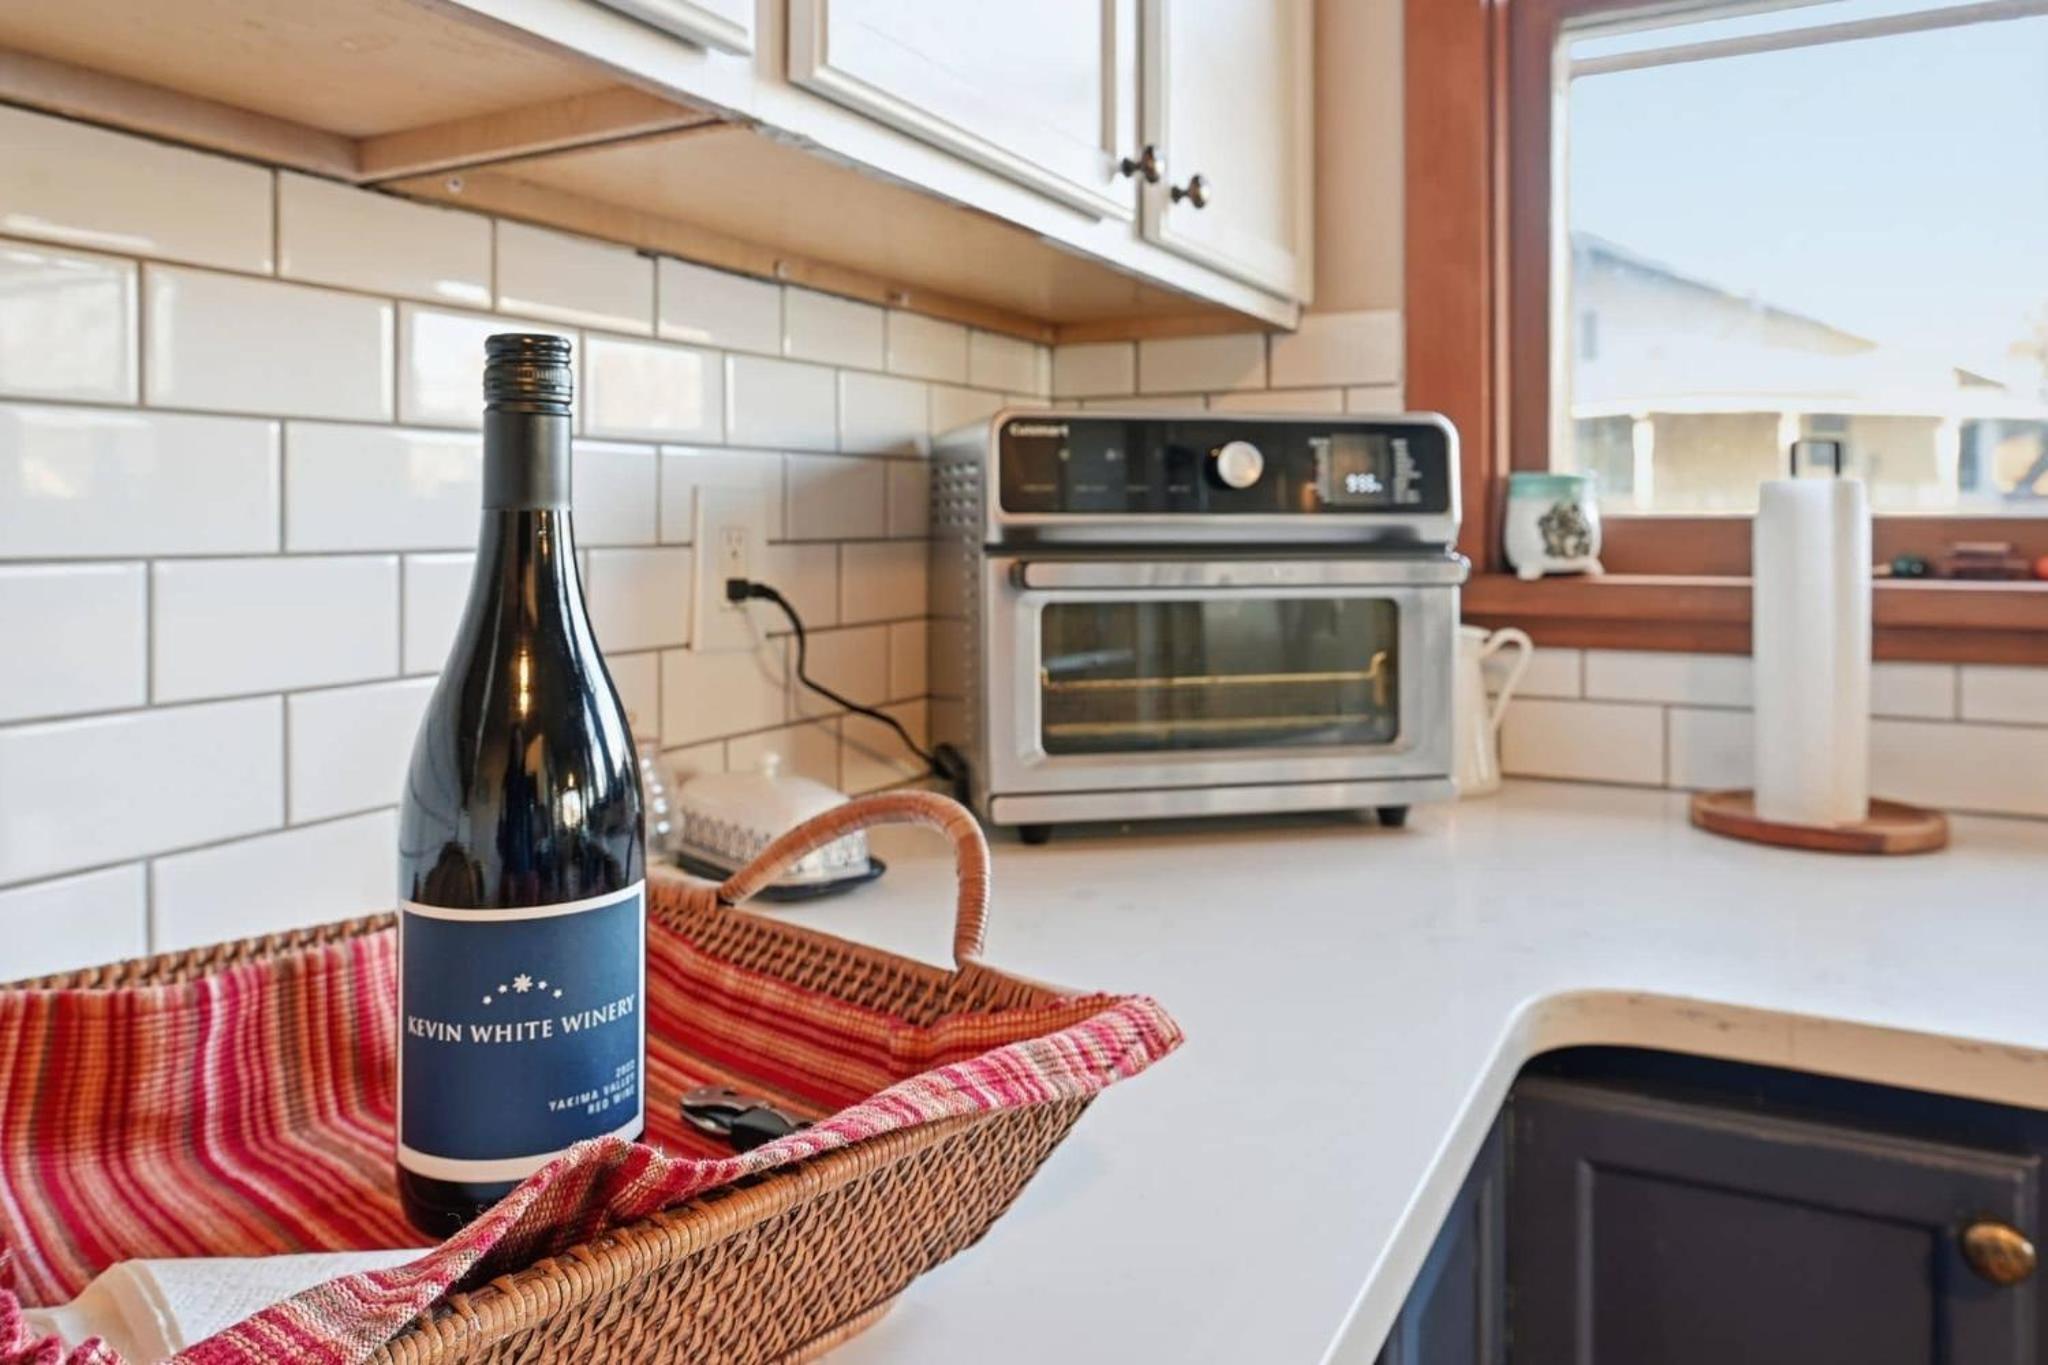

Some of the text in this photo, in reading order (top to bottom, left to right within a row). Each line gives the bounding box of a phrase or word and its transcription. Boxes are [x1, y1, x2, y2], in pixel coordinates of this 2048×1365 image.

[408, 994, 635, 1043] KEVIN WHITE WINERY
[548, 1072, 635, 1112] YAKIMA VALLEY
[587, 1086, 635, 1115] RED WINE
